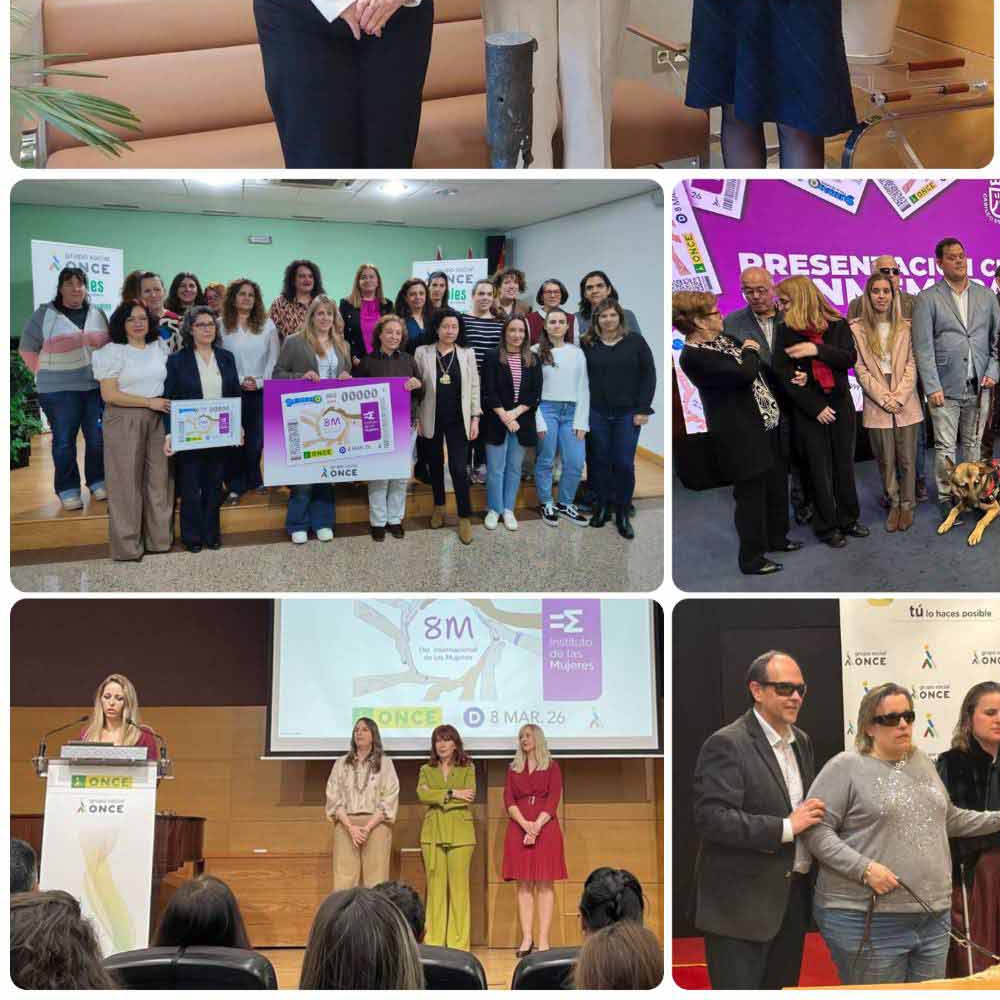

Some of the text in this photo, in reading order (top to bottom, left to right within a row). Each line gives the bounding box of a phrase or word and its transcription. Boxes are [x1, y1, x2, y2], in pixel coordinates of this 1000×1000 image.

[341, 389, 379, 402] 00000
[323, 416, 341, 427] 8M
[330, 469, 359, 477] ONCE
[909, 604, 992, 619] tú lo haces posible
[424, 616, 475, 640] 8M
[550, 637, 593, 647] Instituto
[549, 660, 595, 673] Mujeres
[855, 657, 887, 666] ONCE
[919, 690, 951, 699] ONCE
[379, 711, 438, 725] ONCE
[489, 711, 499, 724] 8
[504, 711, 544, 724] MAR.
[545, 711, 566, 724] 26
[89, 777, 129, 788] ONCE
[88, 804, 125, 814] ONCE
